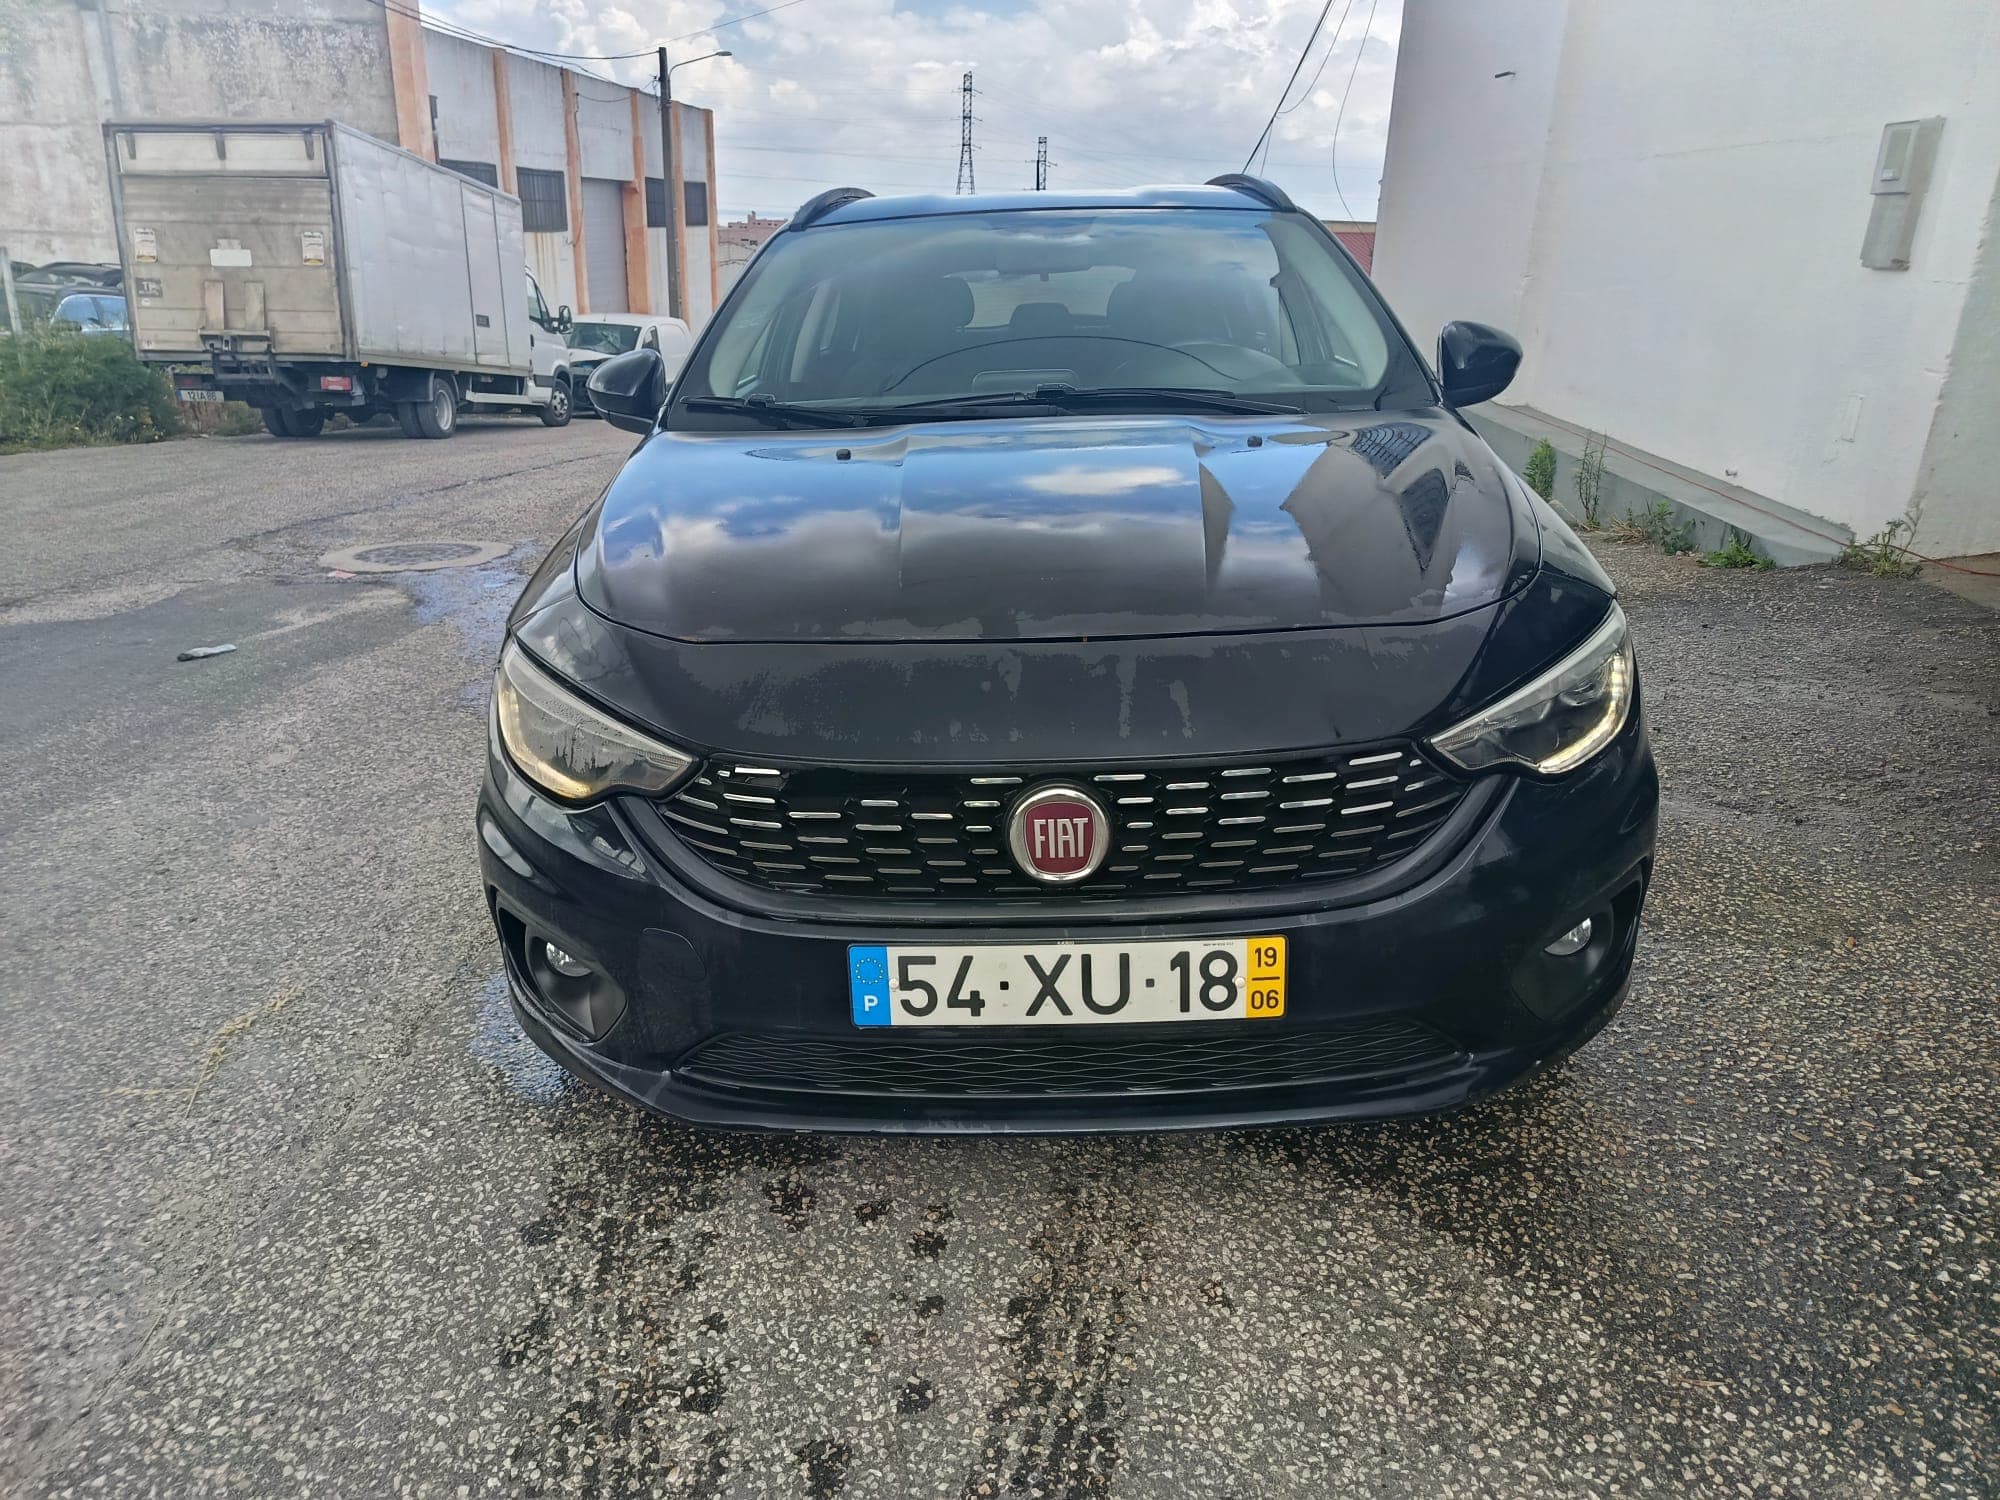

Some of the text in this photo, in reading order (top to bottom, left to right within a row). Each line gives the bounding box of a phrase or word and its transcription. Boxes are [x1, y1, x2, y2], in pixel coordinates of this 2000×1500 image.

[1034, 817, 1088, 859] FIAT
[1254, 946, 1278, 968] 19
[863, 995, 879, 1012] P
[1251, 989, 1279, 1010] 06
